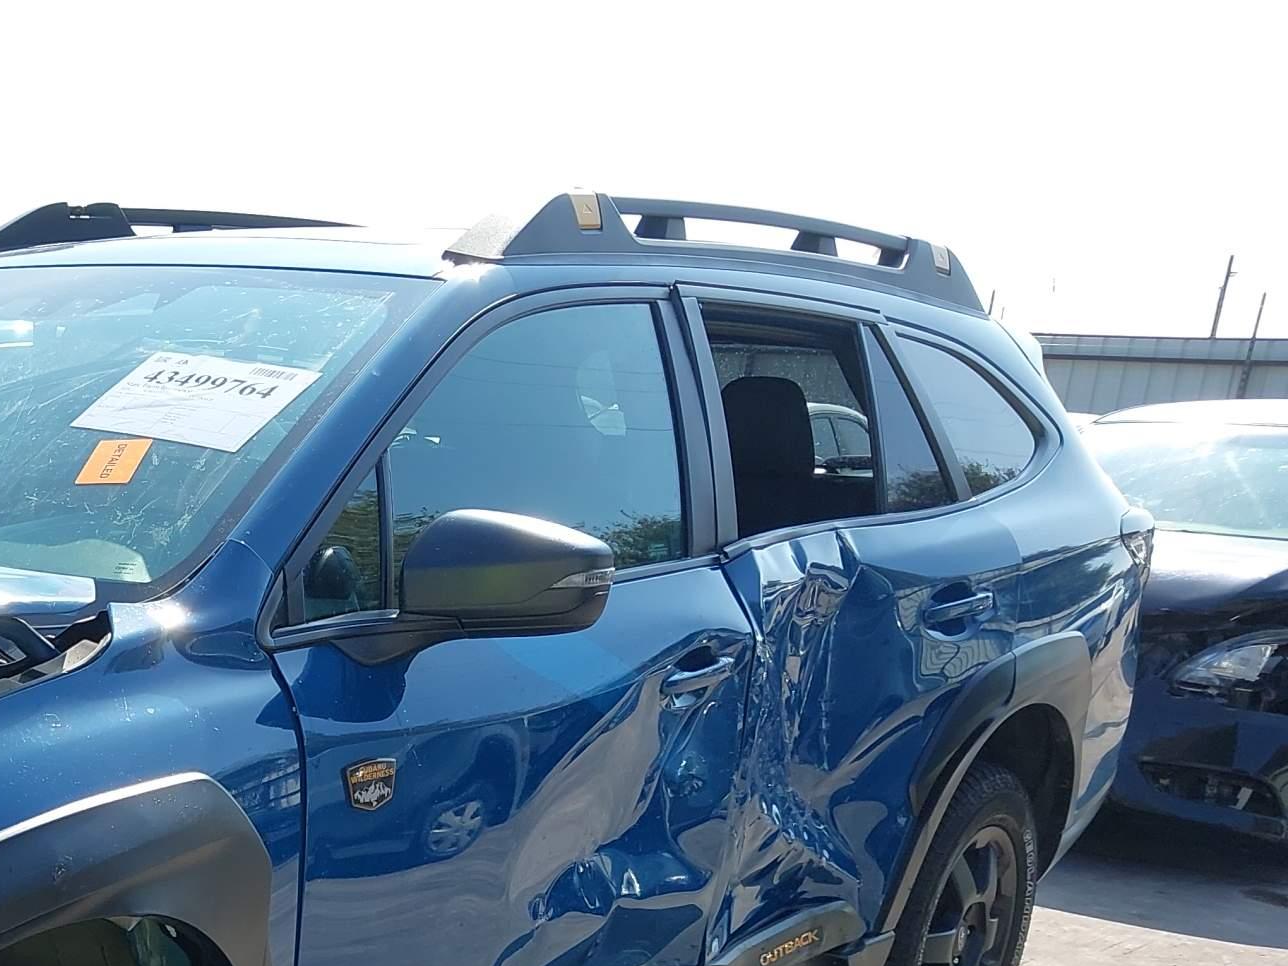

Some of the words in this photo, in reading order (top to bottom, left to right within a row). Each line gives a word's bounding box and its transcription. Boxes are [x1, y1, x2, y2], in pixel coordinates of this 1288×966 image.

[143, 369, 279, 399] 43499764
[99, 443, 128, 479] DETAILED
[760, 929, 820, 966] OUTBACK
